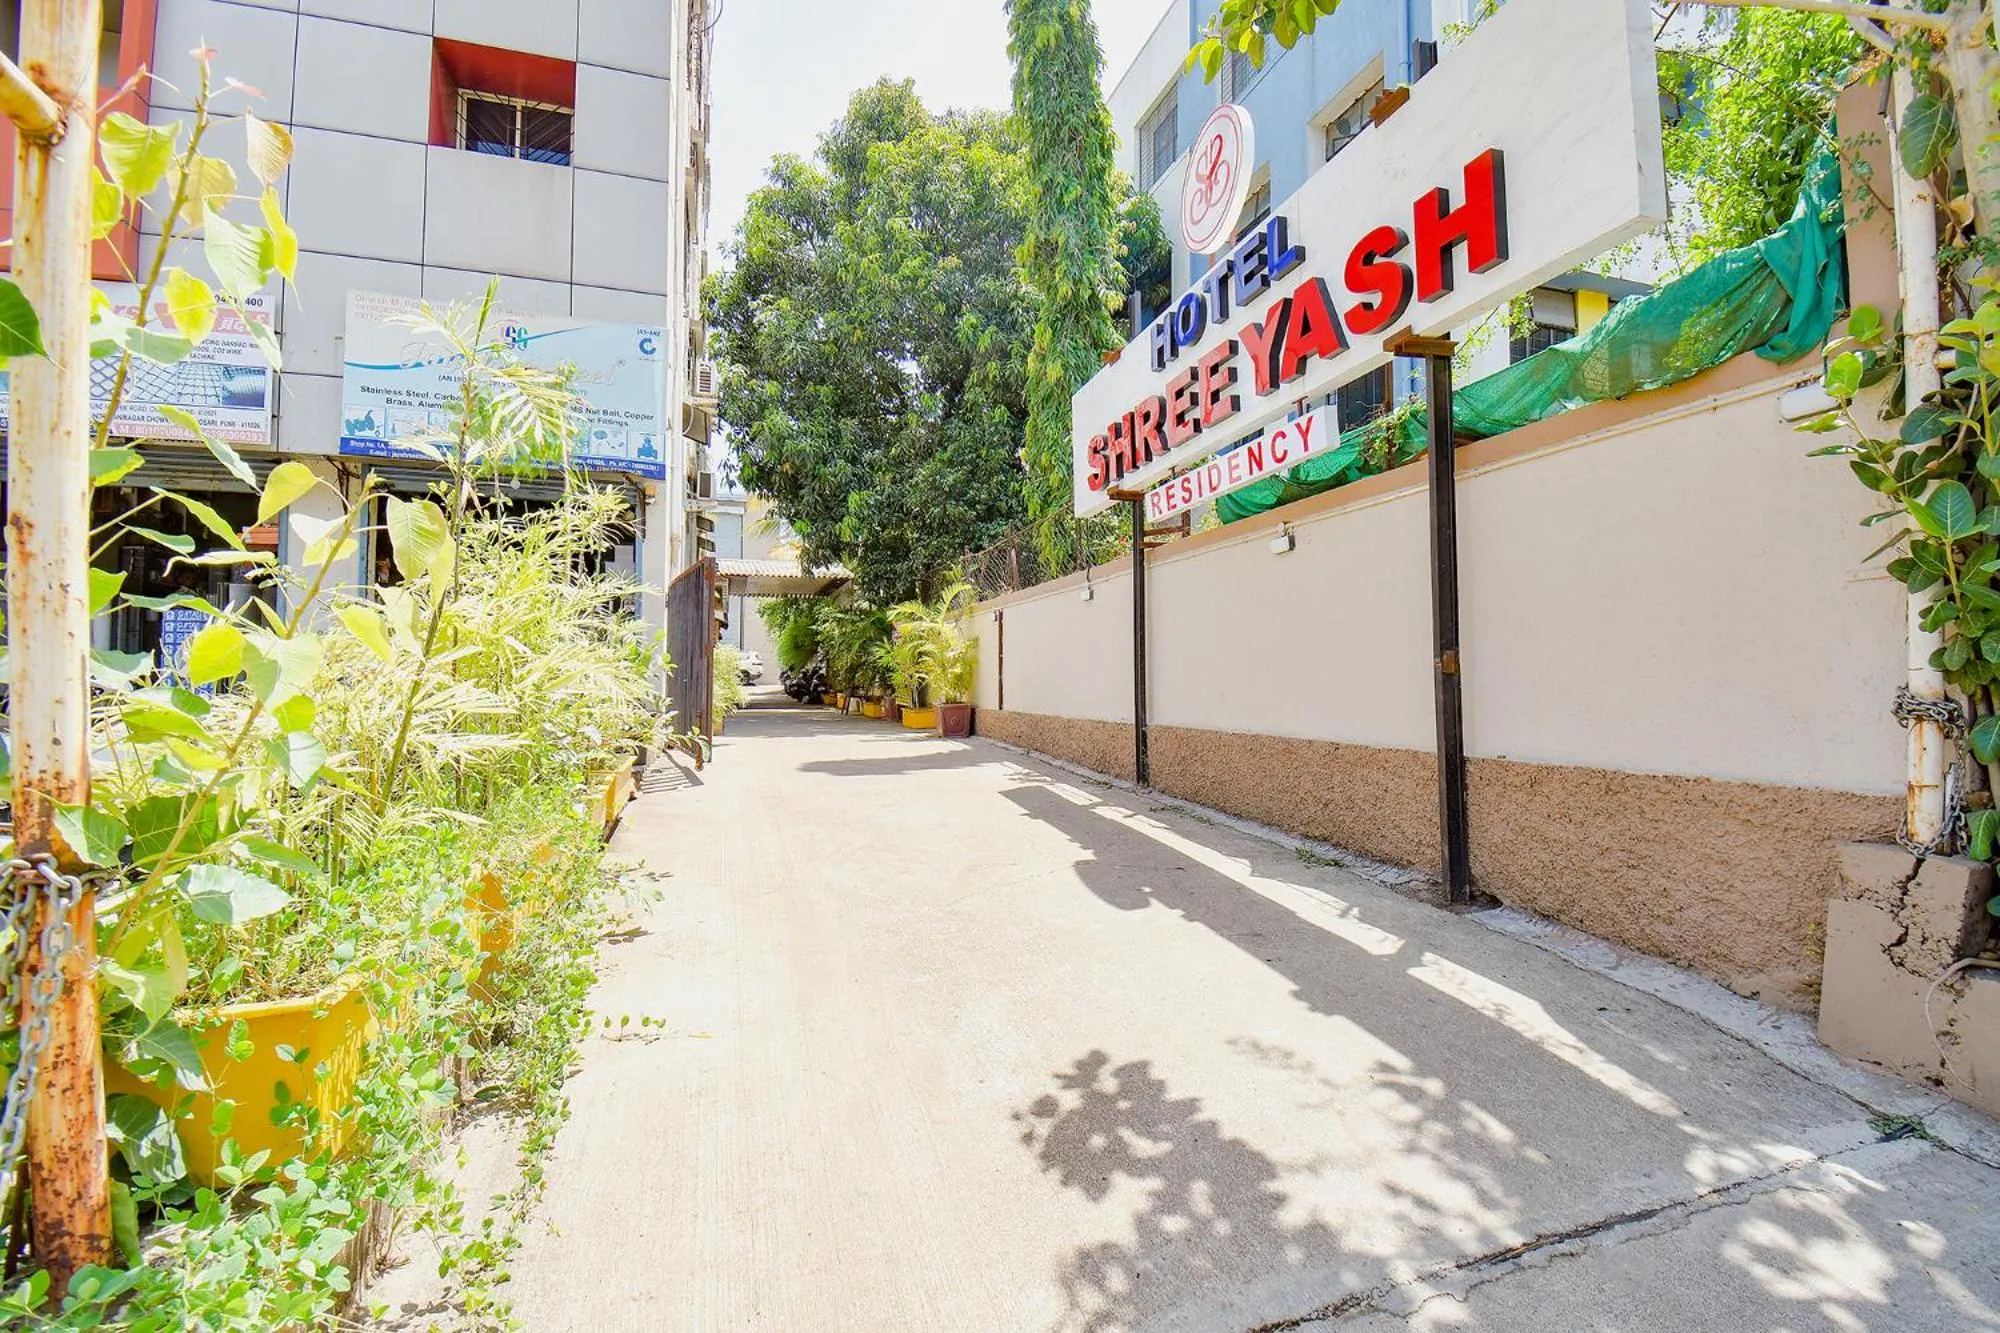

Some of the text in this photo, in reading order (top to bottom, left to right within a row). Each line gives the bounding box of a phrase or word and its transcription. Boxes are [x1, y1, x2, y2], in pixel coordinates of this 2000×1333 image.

[1087, 147, 1509, 492] SHREEYASH
[1151, 215, 1305, 372] HOTEL
[359, 384, 404, 397] Stainless
[434, 392, 464, 403] Carbo
[623, 411, 655, 422] Copper
[1150, 415, 1315, 519] RESIDENCY
